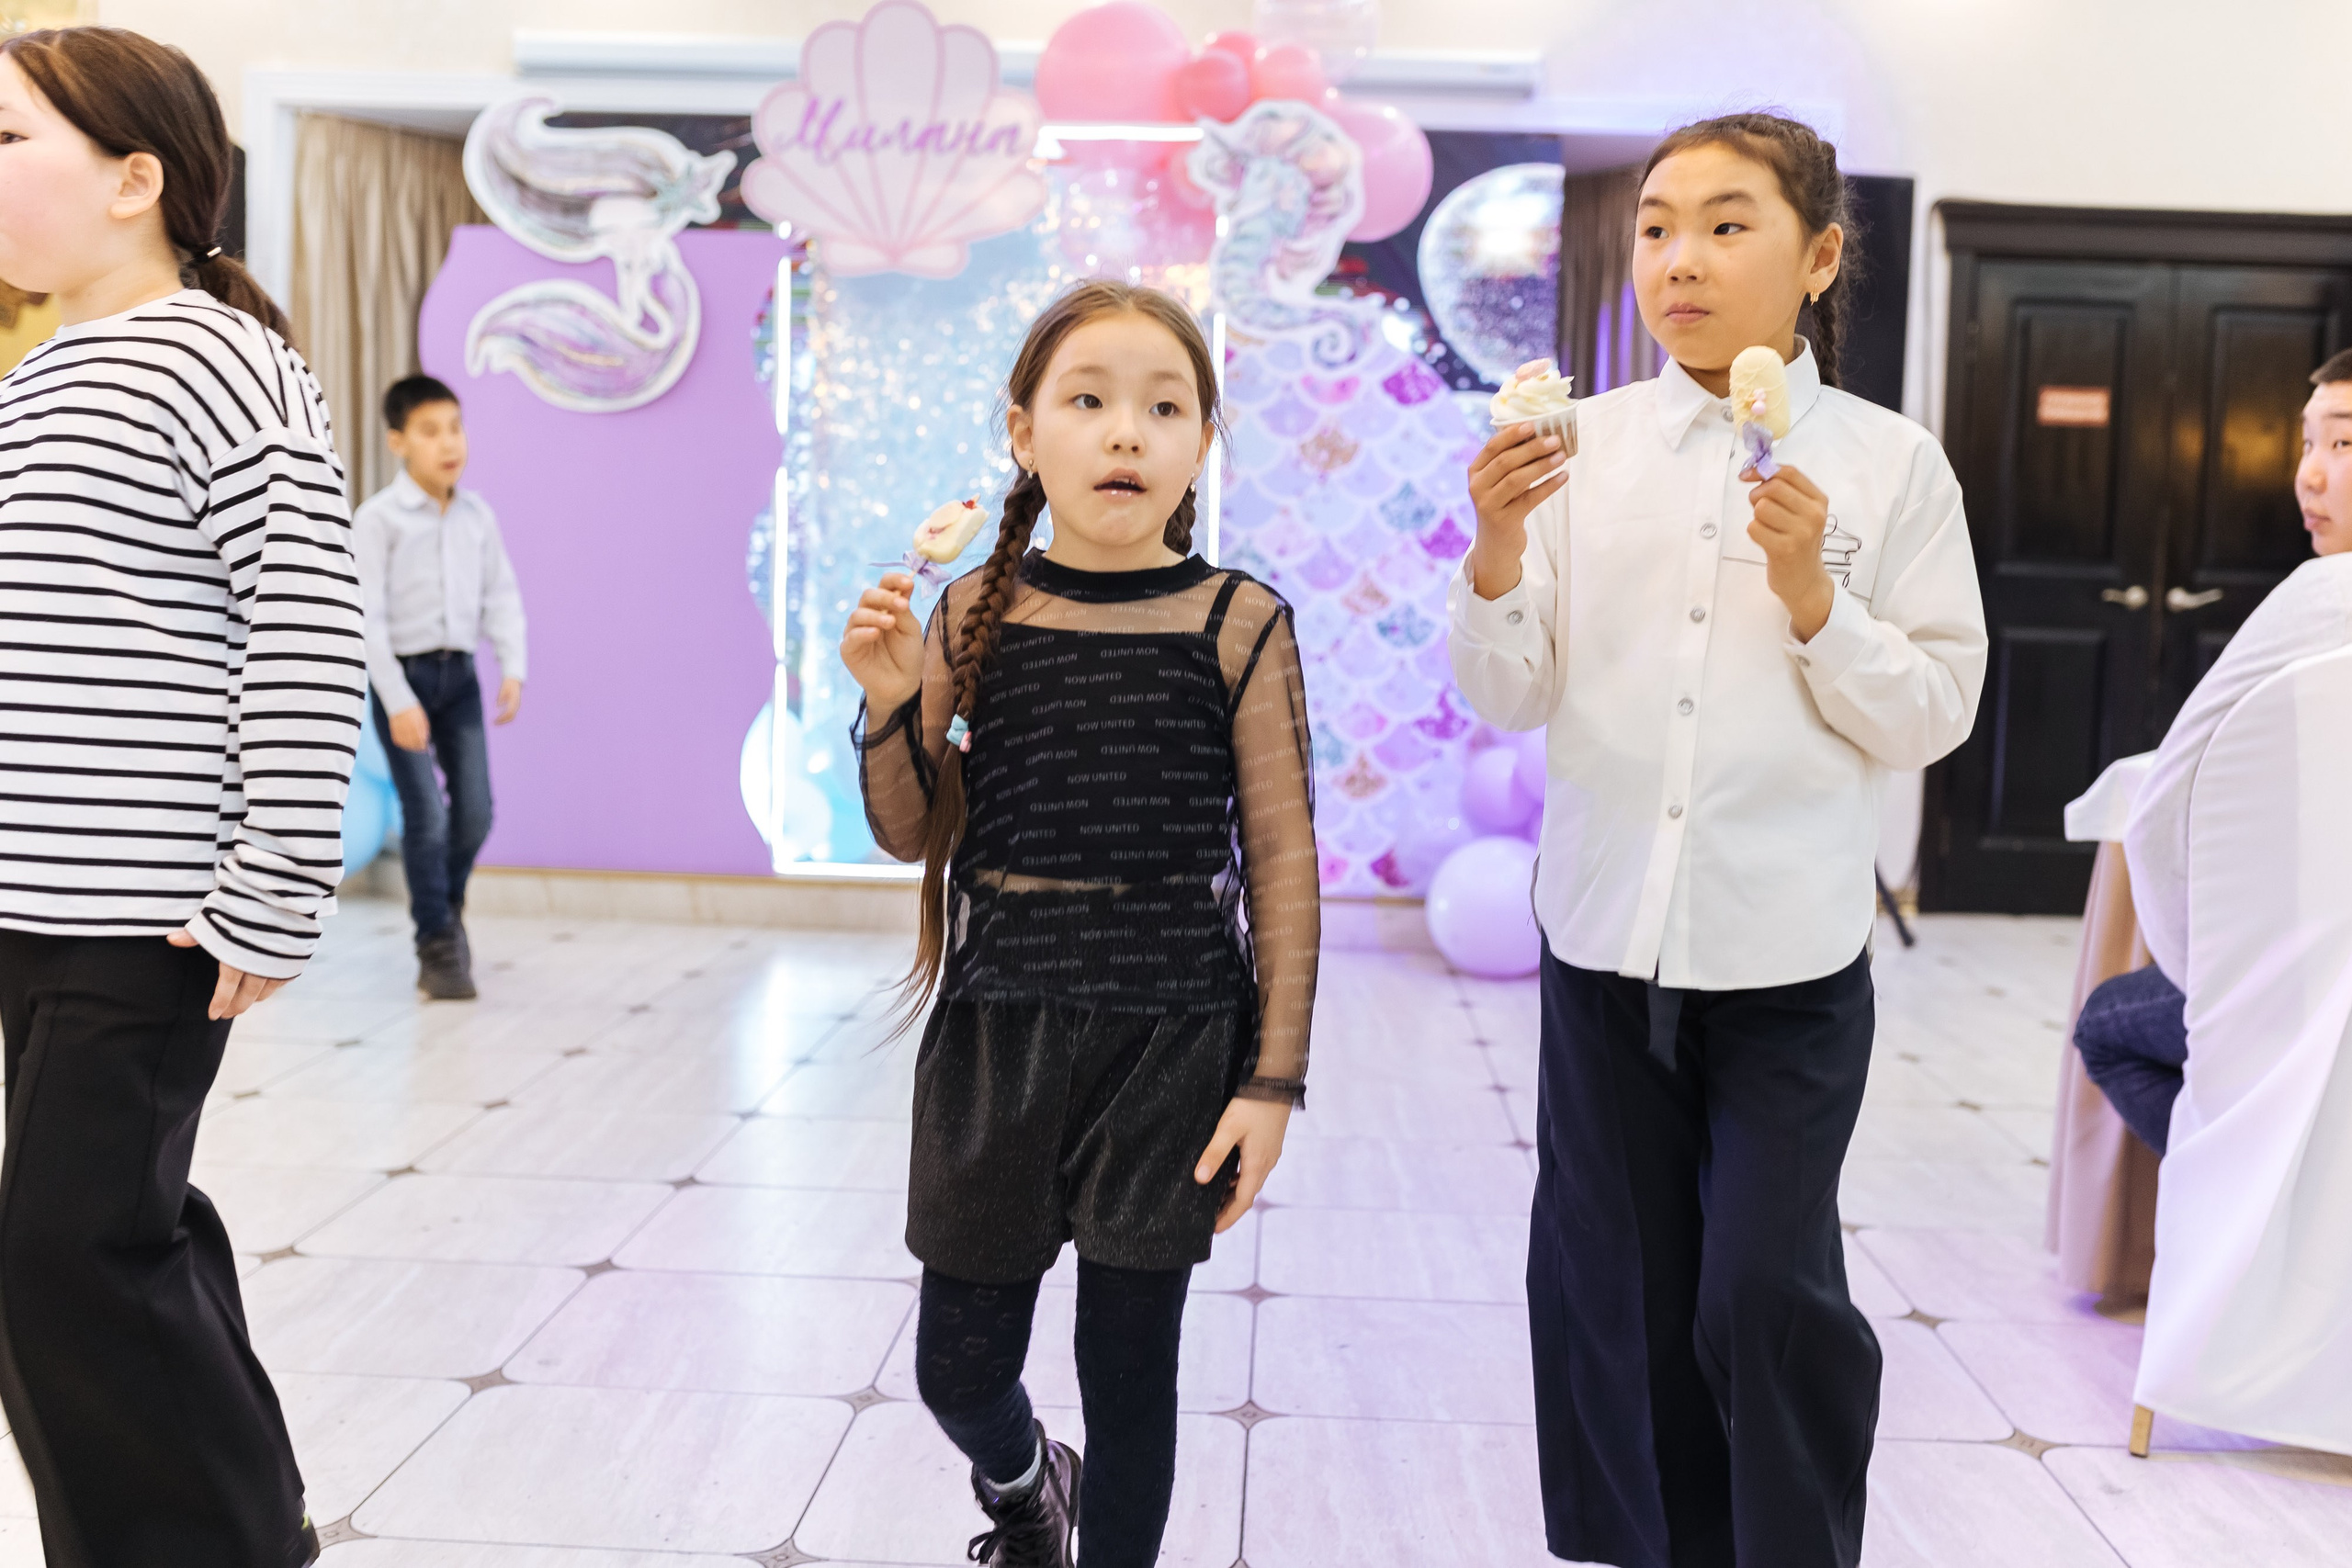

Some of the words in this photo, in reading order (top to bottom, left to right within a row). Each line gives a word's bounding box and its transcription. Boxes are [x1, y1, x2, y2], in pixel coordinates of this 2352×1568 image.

[776, 96, 1022, 165] Милана
[1245, 597, 1266, 609] NOW
[1066, 608, 1087, 619] NOW
[1111, 604, 1145, 615] UNITED
[1148, 607, 1170, 617] NOW
[1232, 618, 1254, 629] NOW
[1184, 629, 1218, 642] UNITED
[1000, 643, 1021, 653] NOW
[1023, 635, 1055, 648] UNITED
[1101, 649, 1133, 658] UNITED
[1136, 648, 1159, 657] NOW
[1057, 653, 1078, 664] NOW
[1022, 659, 1055, 671] UNITED
[1065, 676, 1087, 684] NOW
[1089, 671, 1122, 683] UNITED
[1159, 669, 1182, 678] NOW
[1184, 671, 1216, 687] UNITED
[989, 692, 1007, 704] NOW
[1009, 682, 1040, 696] UNITED
[1146, 693, 1170, 702] NOW
[1064, 699, 1087, 708] NOW
[1109, 694, 1144, 705] UNITED
[1032, 701, 1062, 716] UNITED
[1076, 722, 1100, 732] NOW
[1101, 719, 1136, 729] UNITED
[1155, 718, 1175, 728] NOW
[1177, 719, 1206, 729] UNITED
[1004, 735, 1023, 748] NOW
[1024, 726, 1054, 741] UNITED
[1101, 745, 1136, 755] UNITED
[1137, 744, 1159, 754] NOW
[1025, 750, 1054, 767] UNITED
[1056, 749, 1078, 761] NOW
[1068, 773, 1090, 784] NOW
[1091, 772, 1126, 782] UNITED
[1161, 771, 1182, 780] NOW
[1182, 772, 1209, 781] UNITED
[1066, 799, 1089, 808] NOW
[1113, 797, 1148, 807] UNITED
[1149, 796, 1170, 806] NOW
[1030, 801, 1064, 813] UNITED
[1080, 825, 1102, 835] NOW
[1105, 823, 1139, 833] UNITED
[1163, 823, 1182, 833] NOW
[1183, 823, 1213, 833] UNITED
[1022, 829, 1057, 840] UNITED
[1023, 855, 1057, 866] UNITED
[1059, 852, 1081, 863] NOW
[1111, 851, 1145, 860] UNITED
[1148, 851, 1169, 860] NOW
[1087, 875, 1122, 886] UNITED
[1163, 876, 1183, 885] NOW
[1066, 905, 1090, 914] NOW
[1114, 903, 1147, 911] UNITED
[1030, 908, 1065, 919] UNITED
[1080, 930, 1102, 940] NOW
[1103, 929, 1136, 938] UNITED
[1160, 929, 1182, 937] NOW
[997, 938, 1020, 947] NOW
[1022, 934, 1057, 945] UNITED
[1058, 959, 1082, 969] NOW
[1110, 954, 1142, 964] UNITED
[1145, 954, 1168, 964] NOW
[1023, 962, 1057, 971] UNITED
[1068, 984, 1091, 993] NOW
[1156, 980, 1177, 989] NOW
[1180, 979, 1211, 988] UNITED
[984, 992, 1007, 1000] NOW
[1146, 1006, 1167, 1014] NOW
